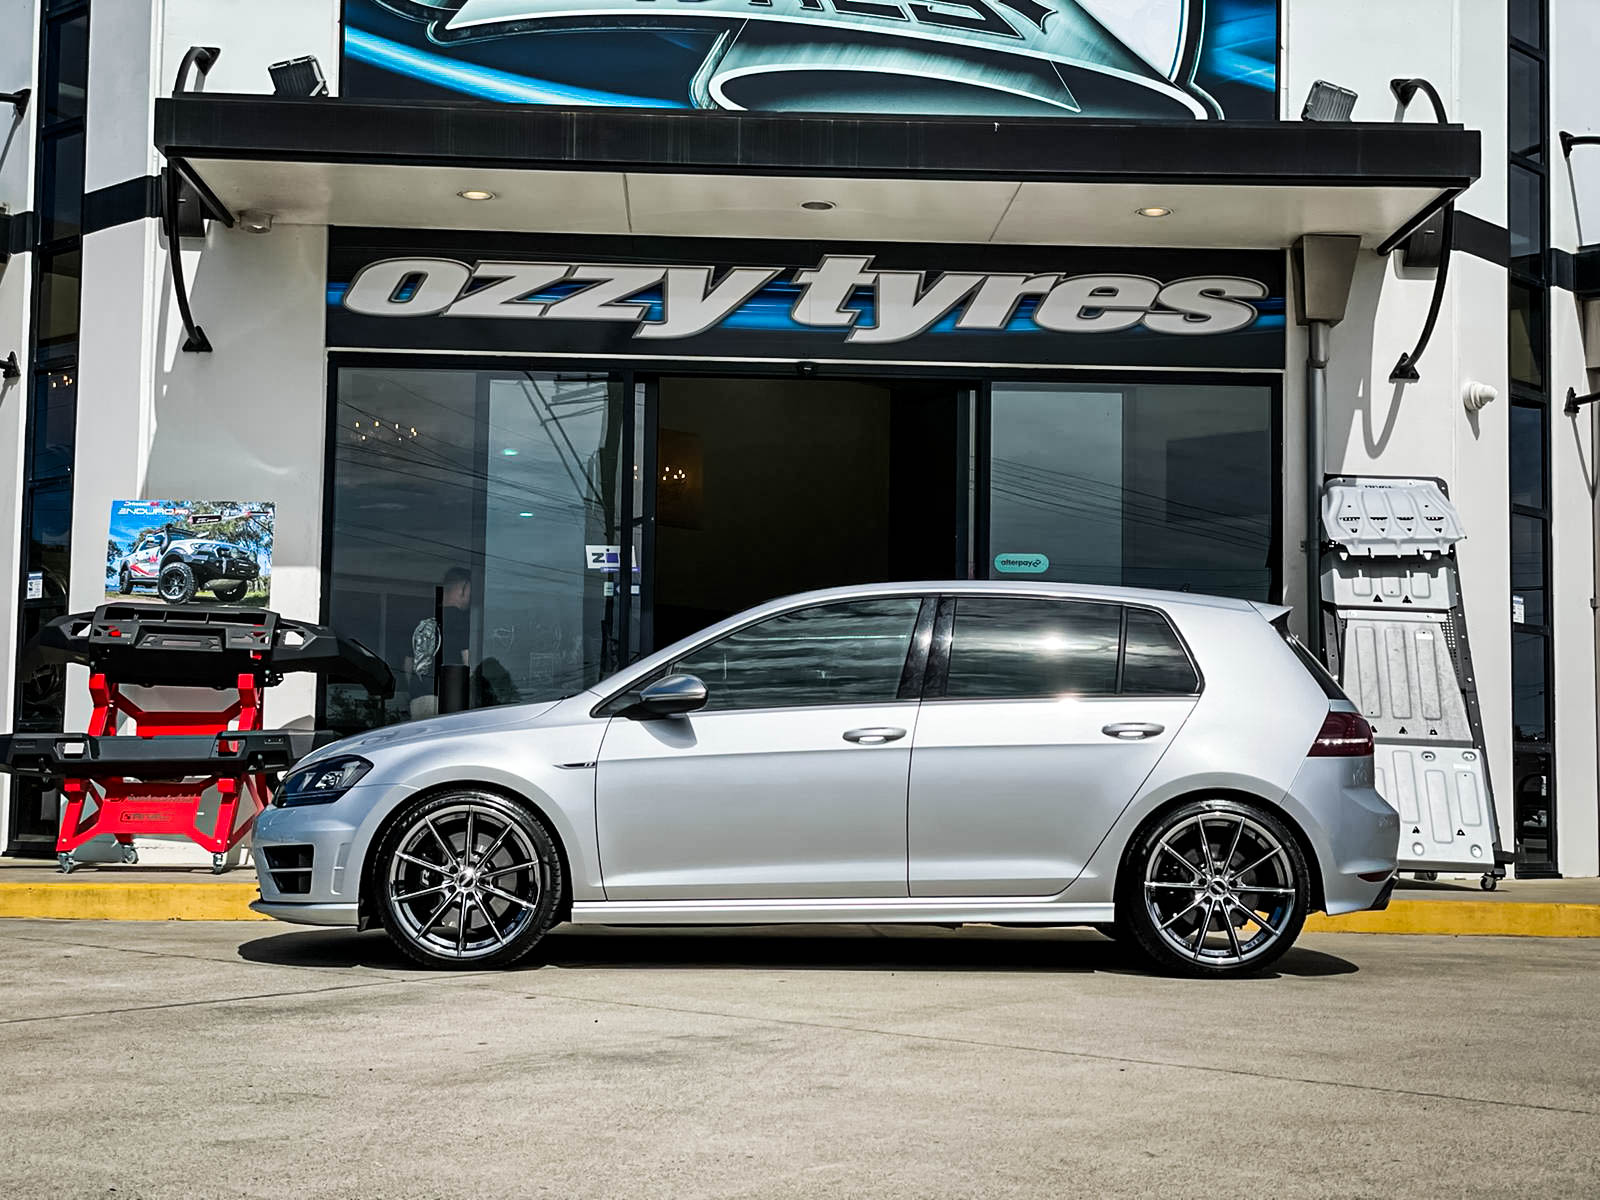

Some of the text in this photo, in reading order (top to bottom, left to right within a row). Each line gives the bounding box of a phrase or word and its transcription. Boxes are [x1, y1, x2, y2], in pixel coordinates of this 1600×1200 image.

[343, 253, 1268, 344] ozzy tyres
[1000, 559, 1033, 567] afterpay
